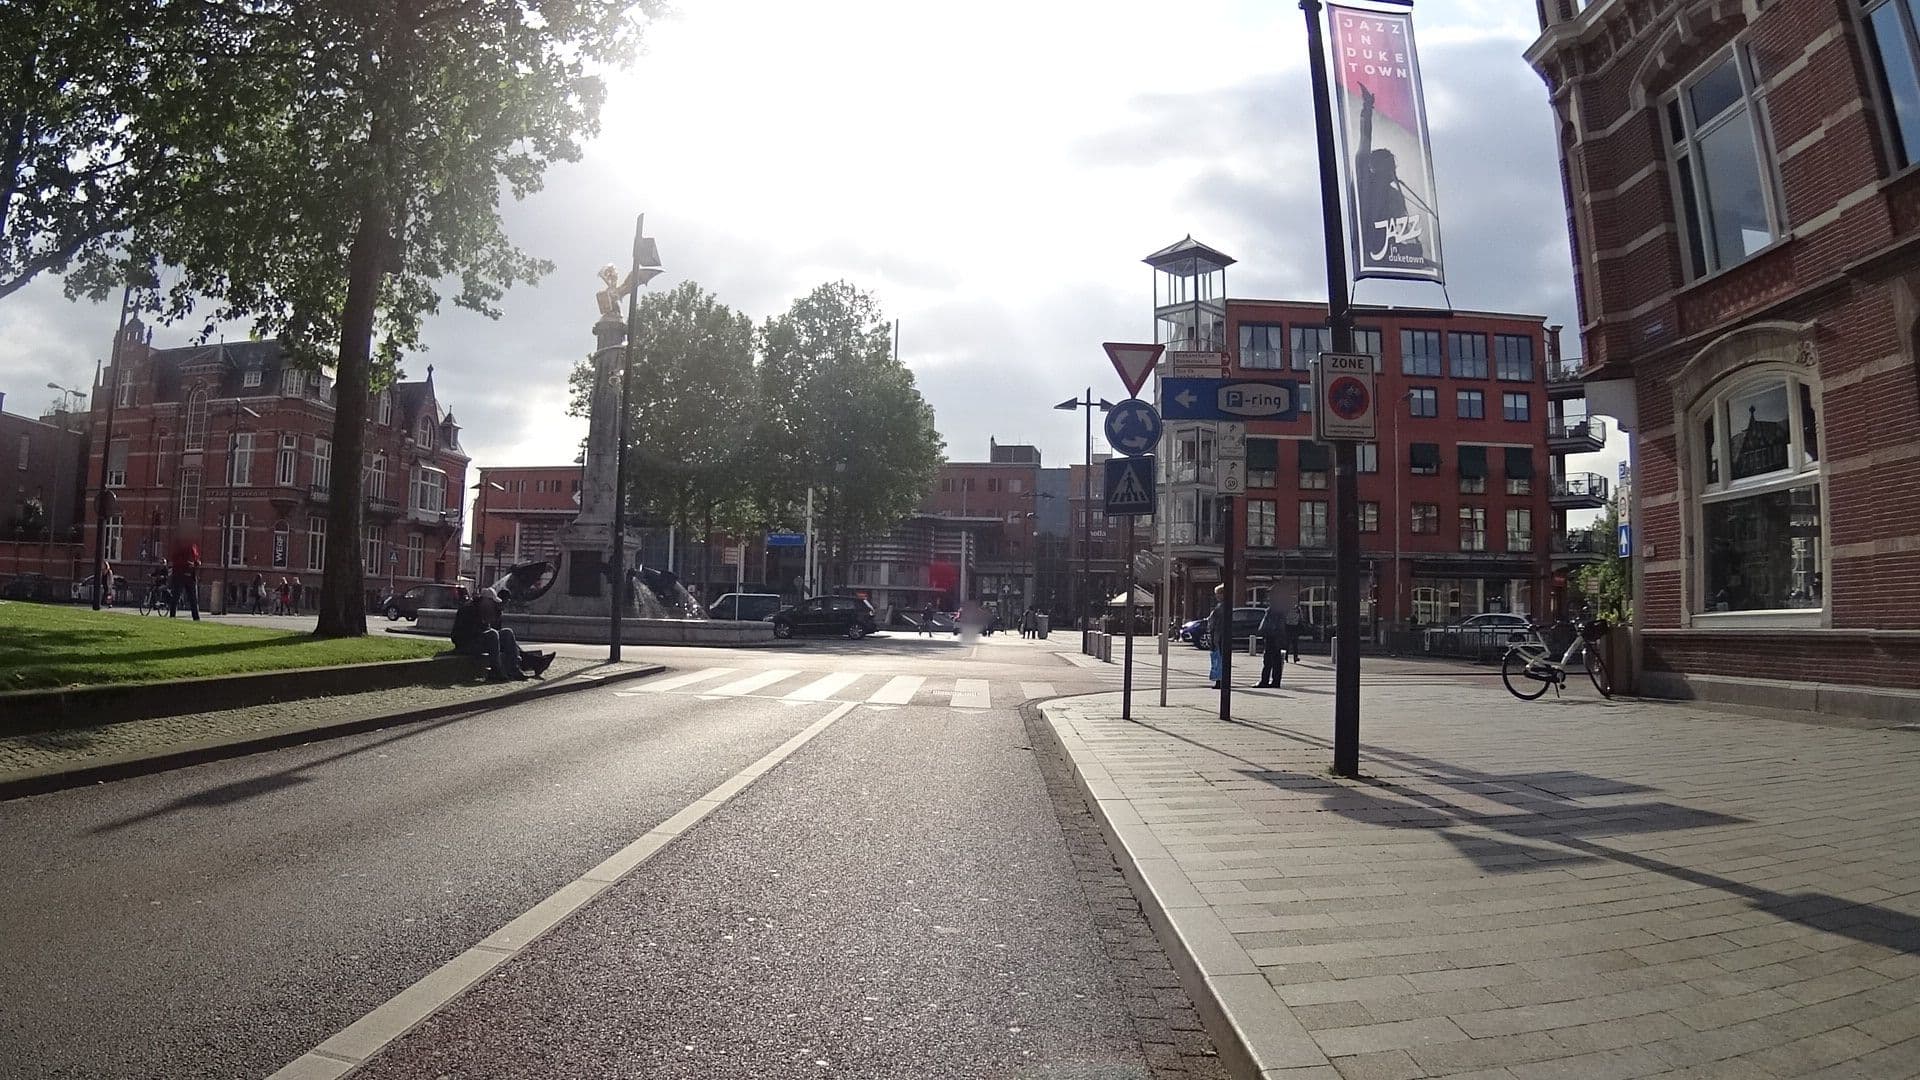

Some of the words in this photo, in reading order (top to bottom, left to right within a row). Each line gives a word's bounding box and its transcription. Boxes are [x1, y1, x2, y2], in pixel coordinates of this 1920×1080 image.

[1343, 18, 1400, 34] JAZZ
[1347, 32, 1371, 45] IN
[1346, 47, 1404, 63] DUKE
[1348, 62, 1407, 78] TOWN
[1388, 253, 1424, 264] duketown
[1331, 358, 1364, 369] ZONE
[275, 535, 284, 562] WERF
